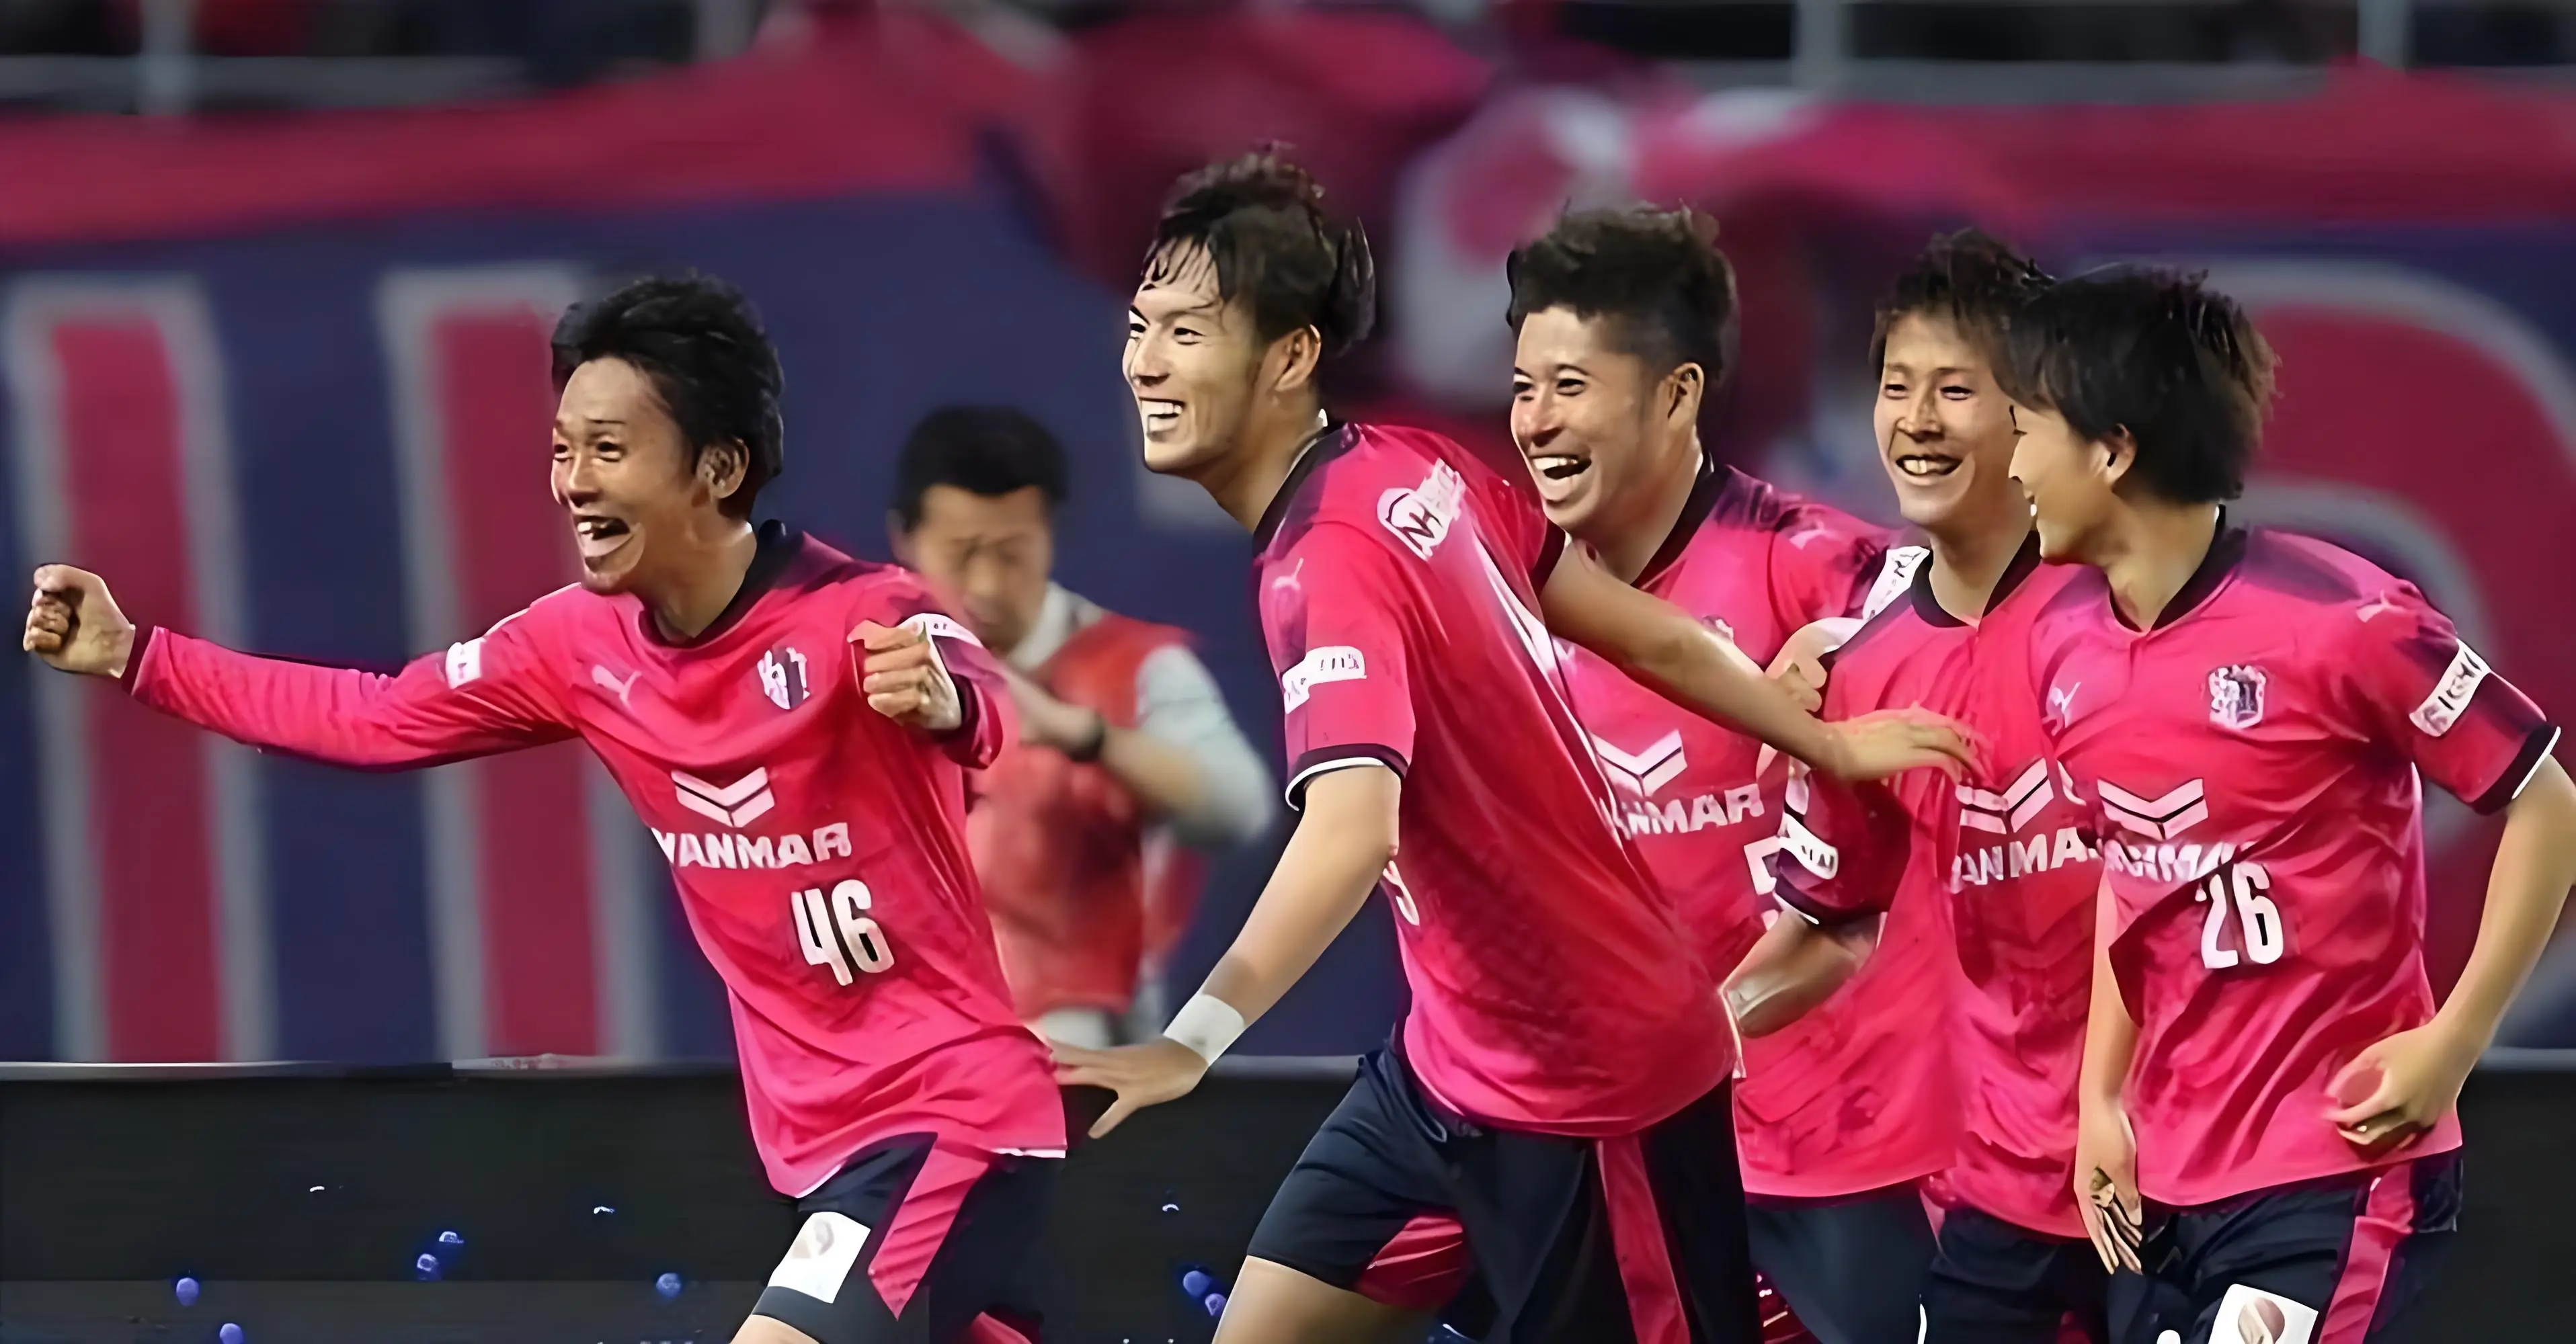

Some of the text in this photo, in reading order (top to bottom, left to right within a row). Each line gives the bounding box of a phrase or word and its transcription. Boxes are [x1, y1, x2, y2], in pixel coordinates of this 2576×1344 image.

[1951, 827, 2099, 894] ANMA
[791, 879, 895, 986] 46
[2195, 861, 2284, 969] 26
